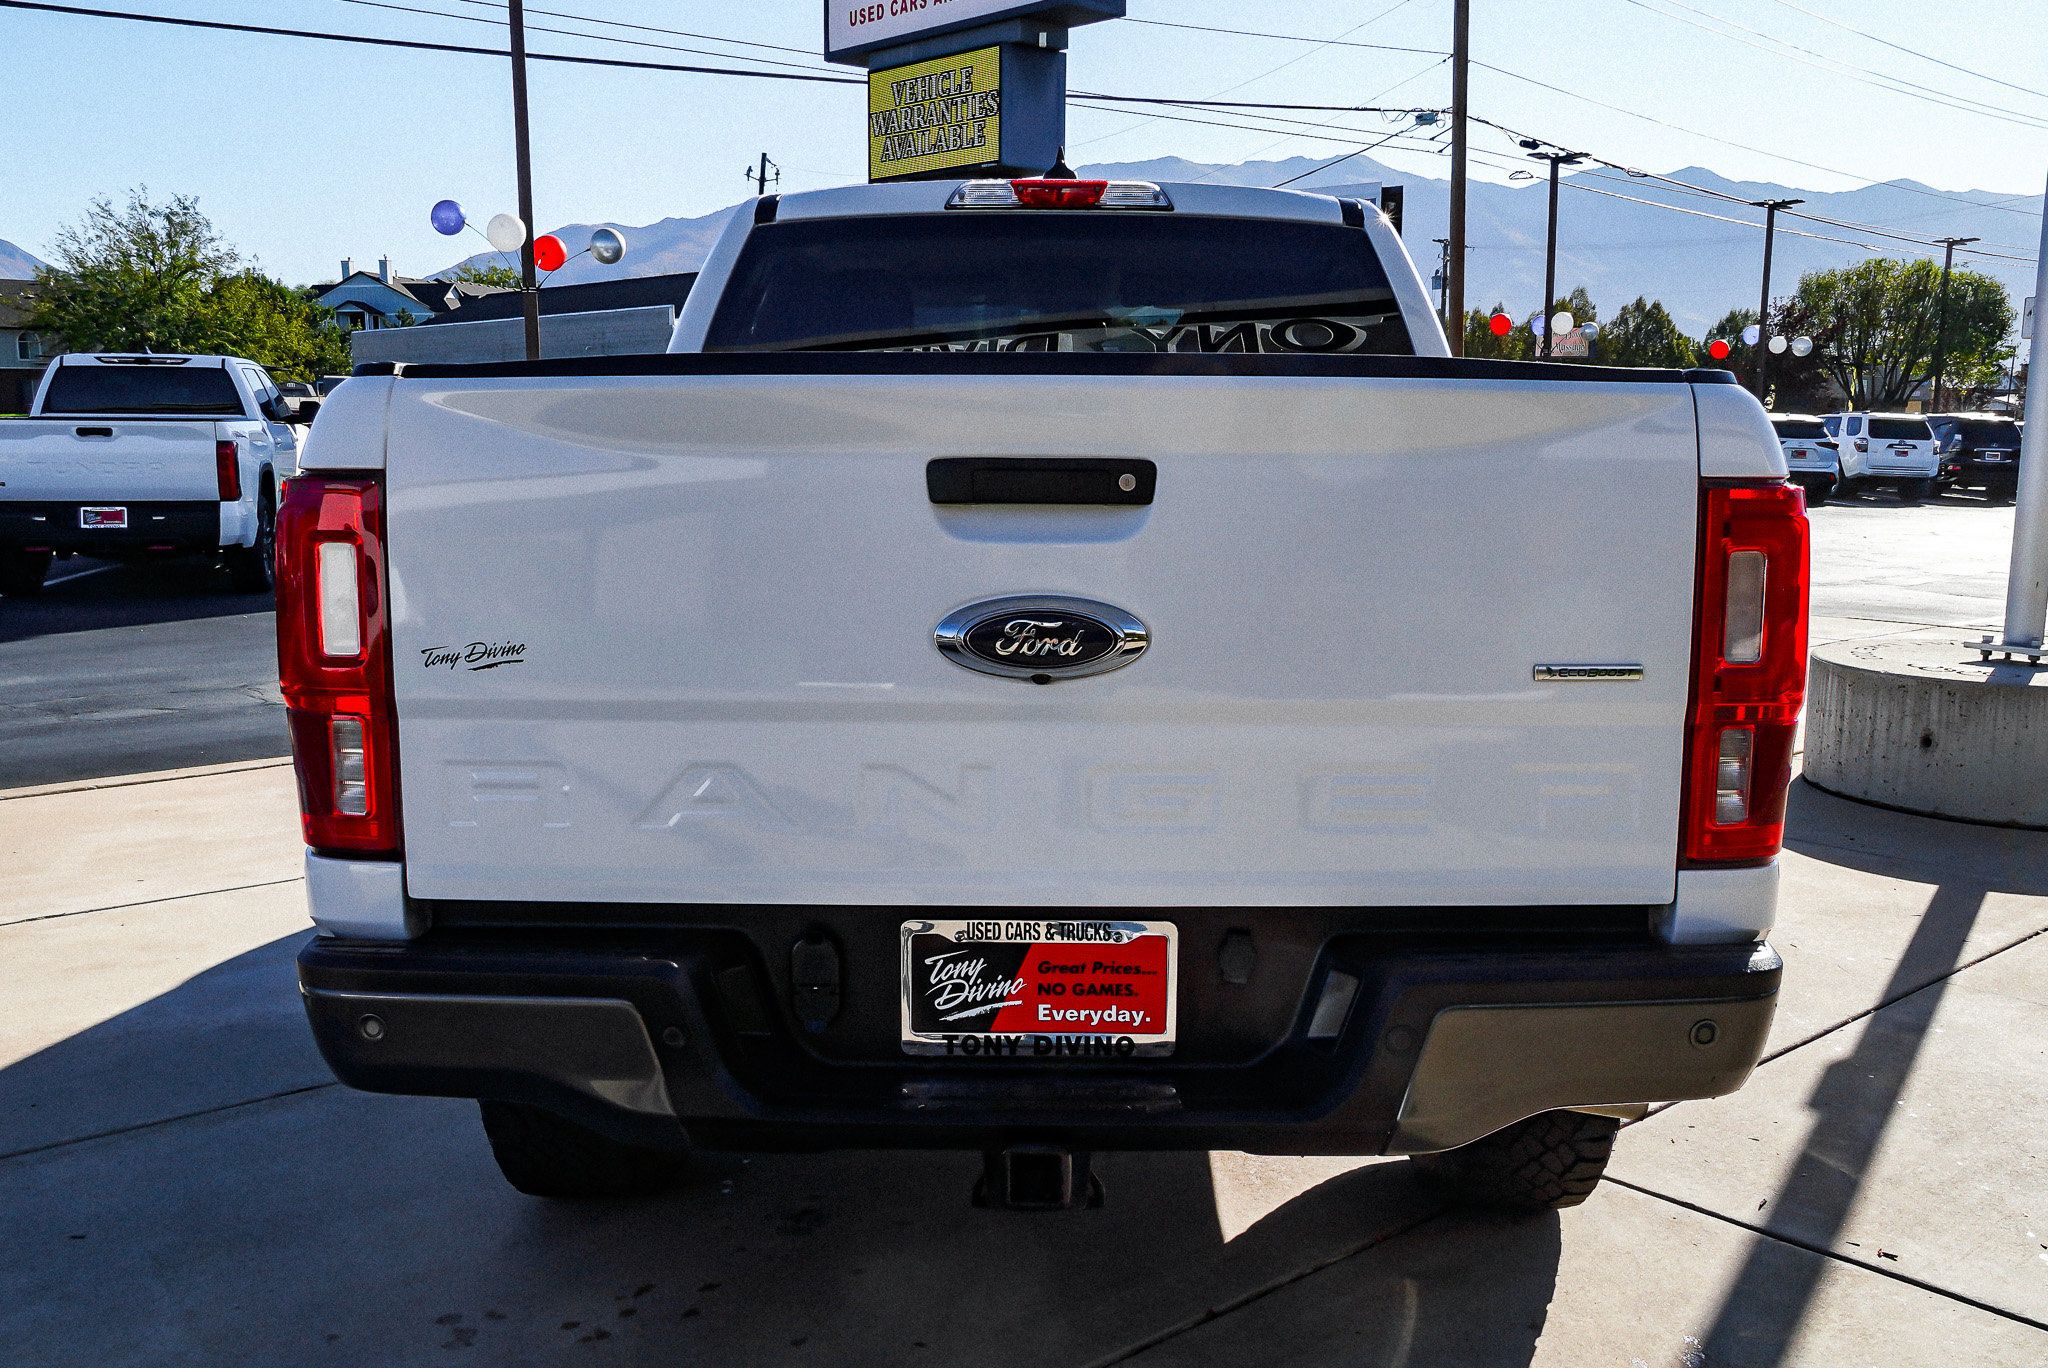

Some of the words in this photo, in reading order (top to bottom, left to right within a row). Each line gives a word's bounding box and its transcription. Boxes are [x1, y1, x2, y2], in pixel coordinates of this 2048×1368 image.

[849, 3, 885, 27] USED
[890, 0, 928, 17] CARS
[891, 66, 973, 107] VEHICLE
[870, 89, 1000, 137] WARRANTIES
[881, 121, 986, 163] AVAILABLE
[995, 619, 1085, 657] Ford
[420, 645, 462, 670] Tony
[464, 640, 527, 663] Divino
[966, 921, 1001, 941] USED
[1005, 921, 1041, 941] CARS
[1045, 922, 1055, 941] &
[1060, 922, 1111, 942] TRUCKS
[924, 949, 988, 985] Tony
[1037, 961, 1088, 975] Great
[925, 974, 1027, 1011] Divino
[1037, 983, 1066, 996] NO
[1071, 983, 1139, 997] GAMES.
[1037, 1004, 1151, 1026] Everyday.
[942, 1034, 1021, 1055] TONY
[1033, 1035, 1136, 1057] DIVINO
